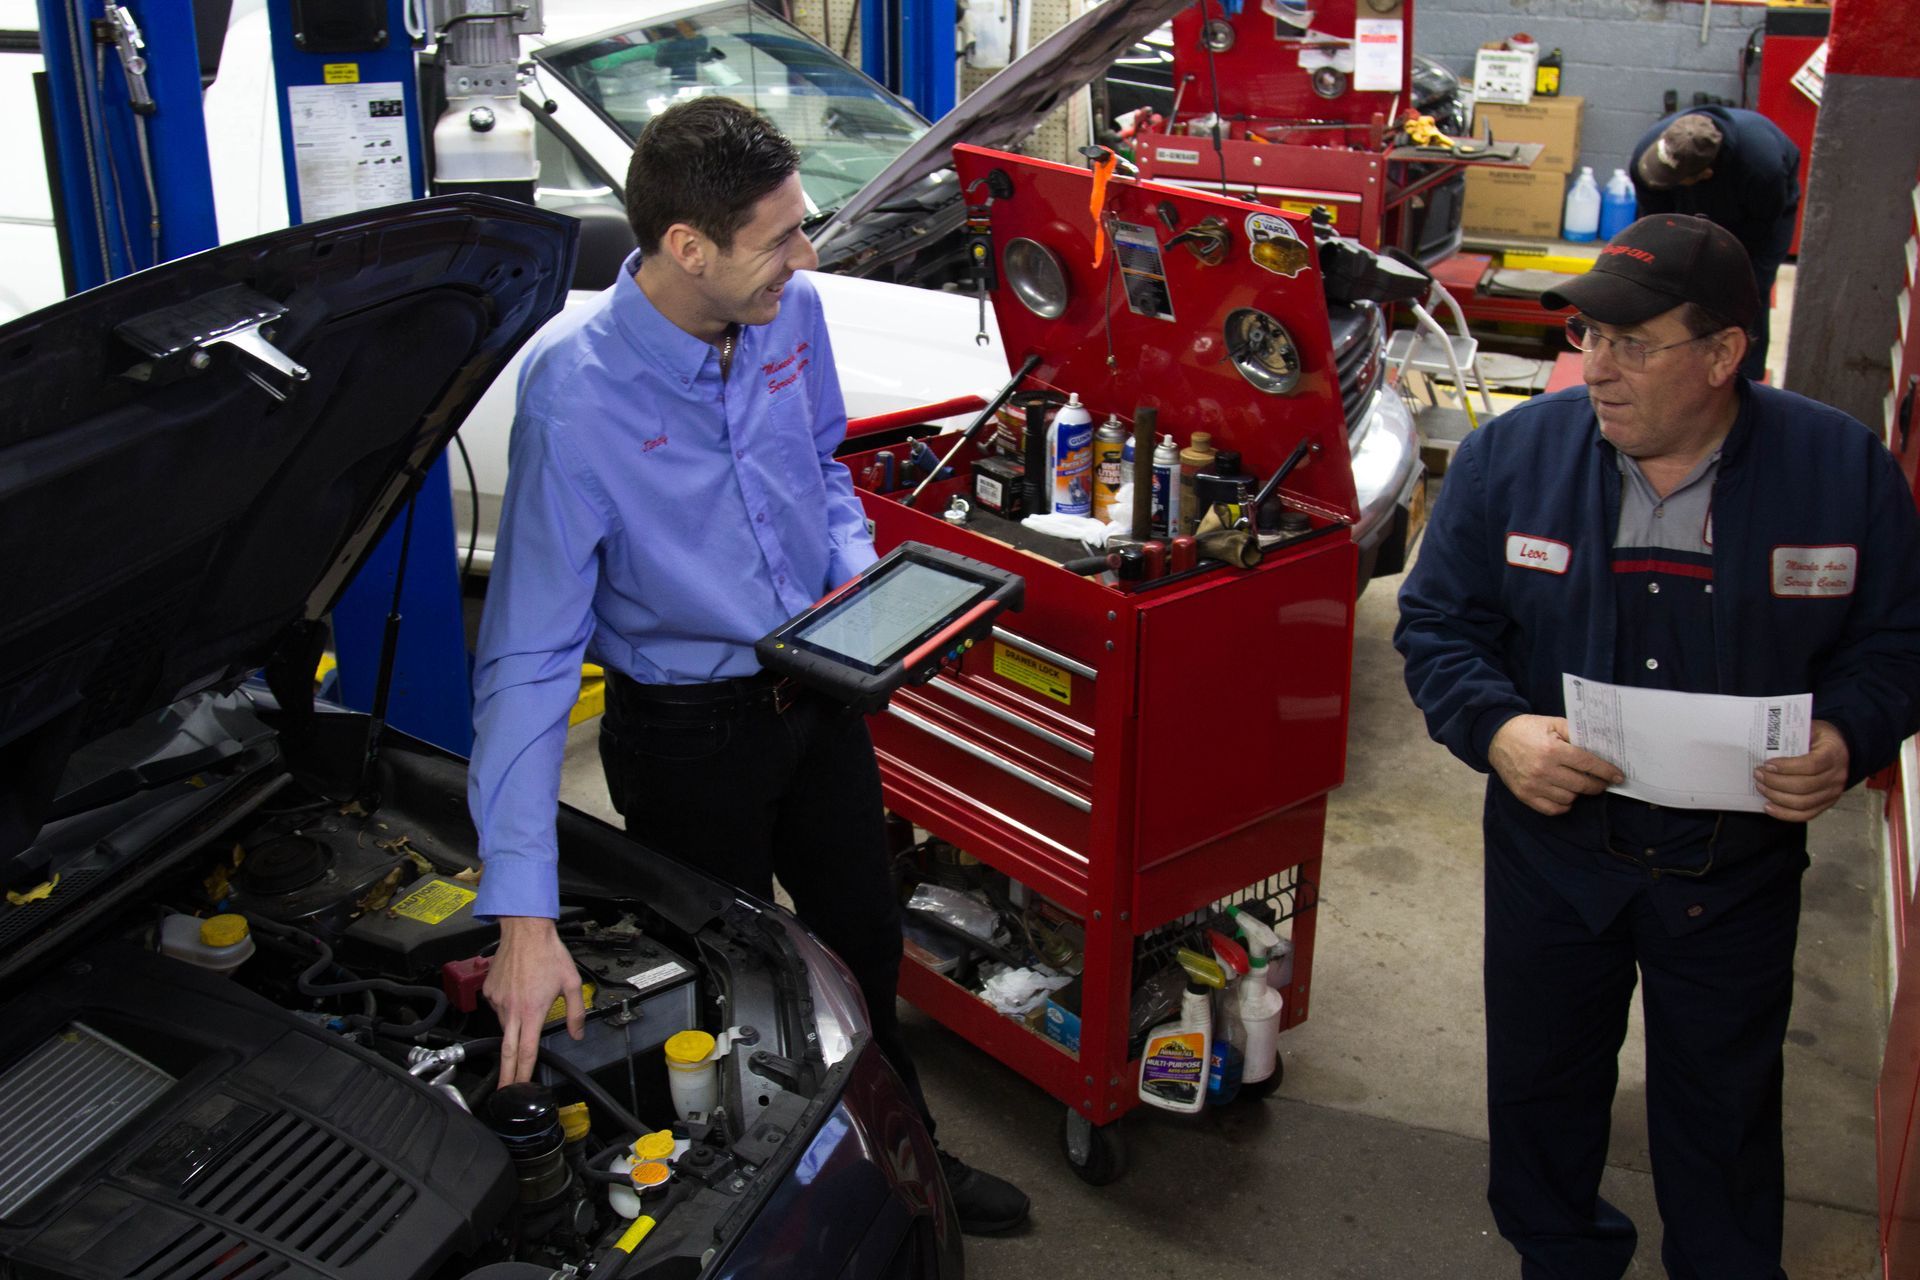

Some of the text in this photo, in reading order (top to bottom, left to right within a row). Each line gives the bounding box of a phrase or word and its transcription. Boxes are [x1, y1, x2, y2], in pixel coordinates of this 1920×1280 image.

[1263, 222, 1290, 236] VARTA
[1101, 463, 1120, 471] WHIT
[1098, 469, 1120, 477] LITHI
[1520, 543, 1549, 561] Leon
[1824, 560, 1848, 571] Auto
[1784, 576, 1847, 587] Service Center
[1005, 648, 1037, 669] DRAWER
[1038, 662, 1060, 678] LOCK
[1146, 1058, 1201, 1068] MULTI-PURPOSE
